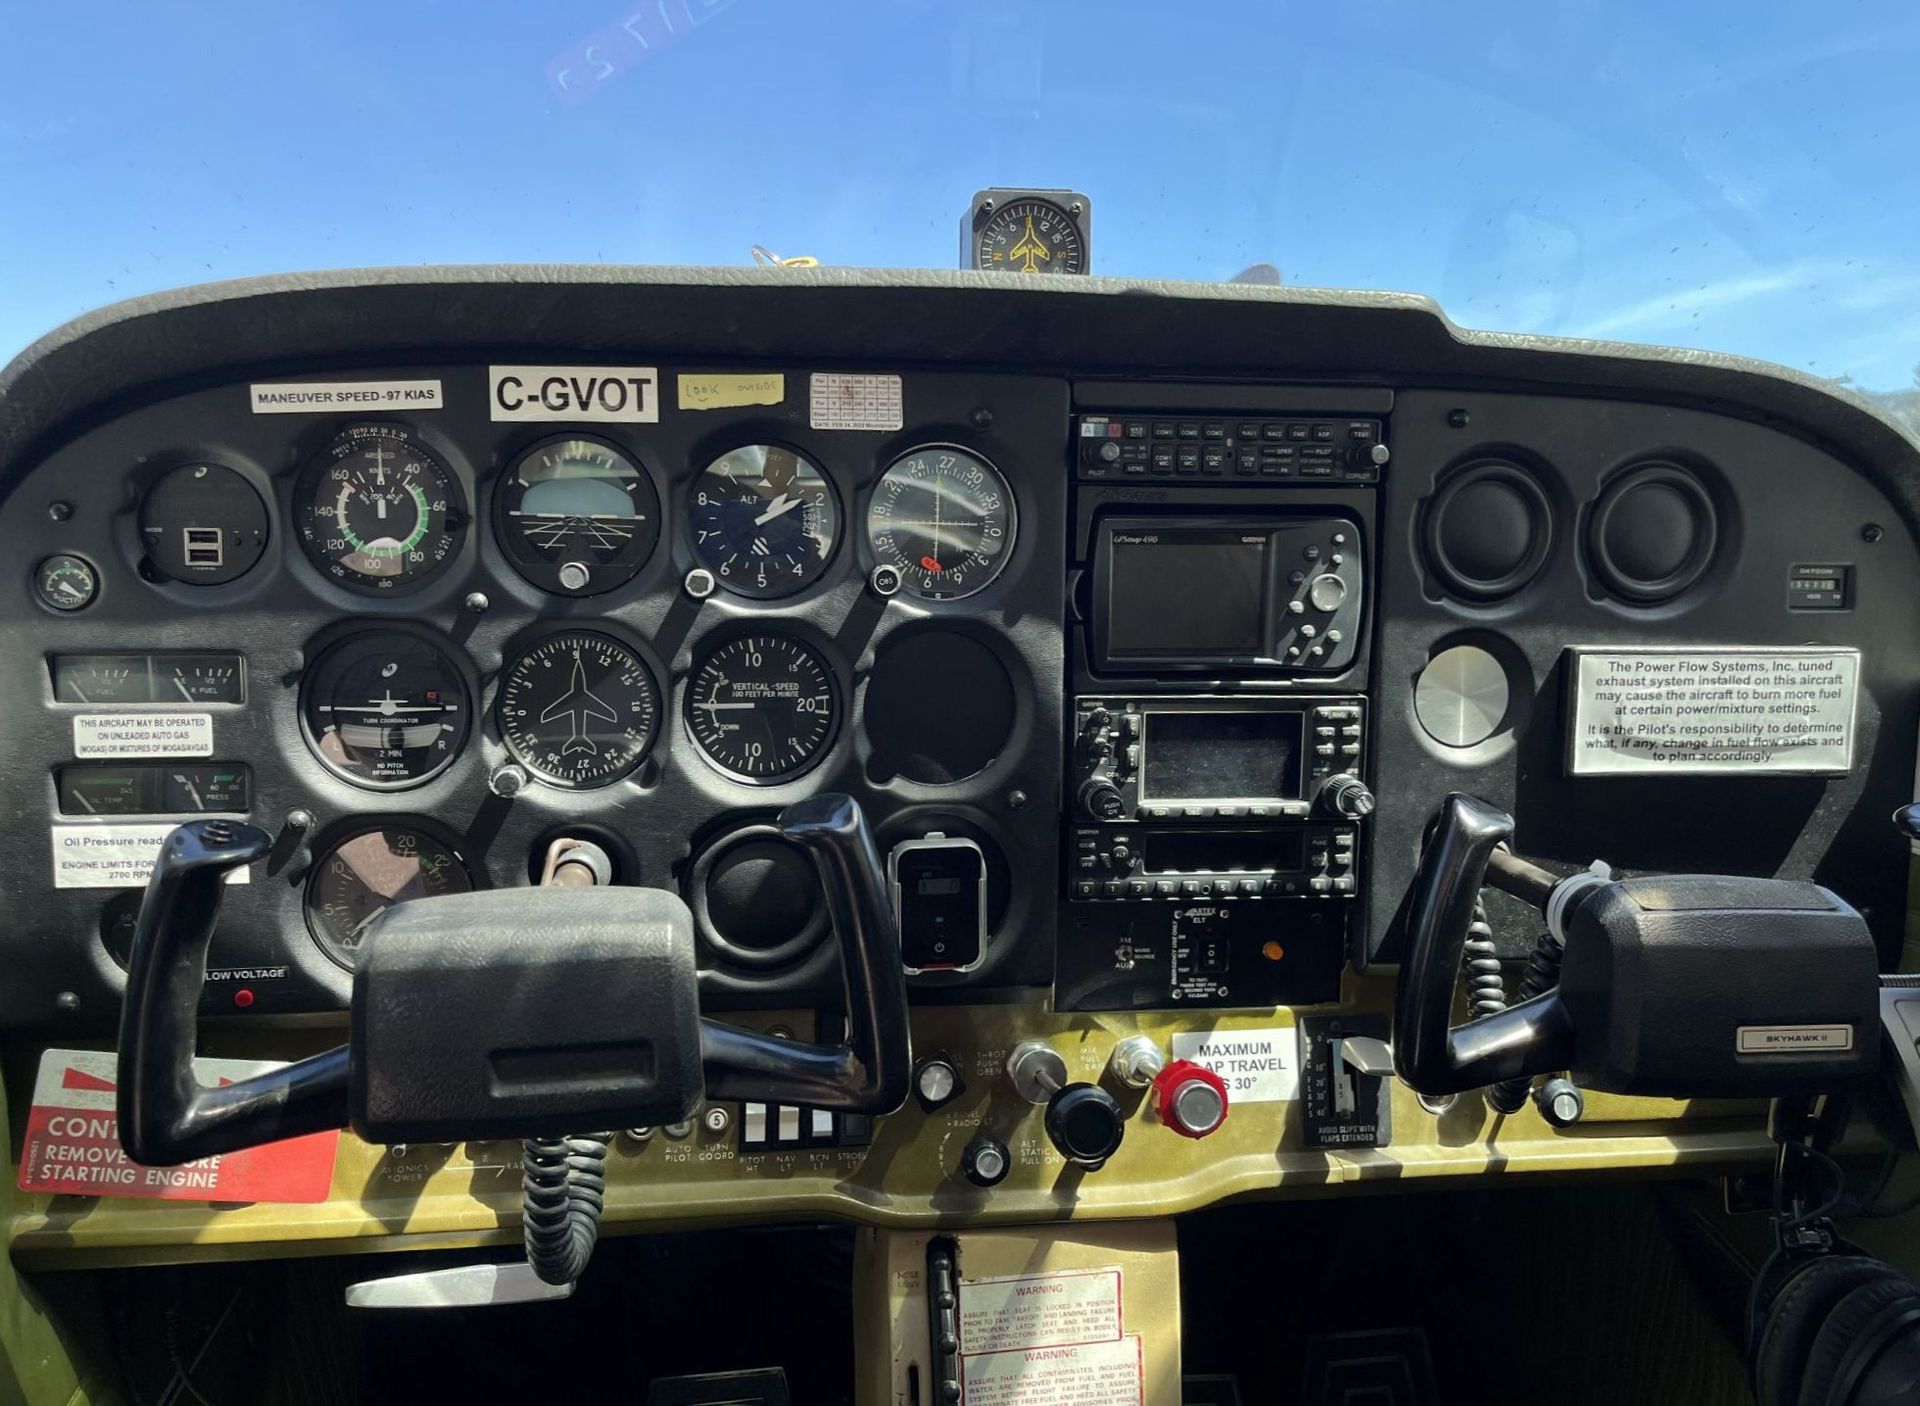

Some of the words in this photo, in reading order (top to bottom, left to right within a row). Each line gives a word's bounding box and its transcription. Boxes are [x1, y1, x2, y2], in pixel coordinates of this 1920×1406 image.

[1039, 221, 1050, 232] 12
[258, 392, 333, 404] MANEUVER
[404, 389, 435, 400] KIAS
[496, 377, 652, 413] C-GVOT
[404, 463, 420, 474] 40
[907, 459, 925, 474] 24
[939, 456, 956, 469] 27
[331, 469, 349, 480] 160
[965, 467, 984, 484] 30
[698, 492, 707, 506] 8
[740, 495, 758, 504] ALT
[815, 493, 824, 506] 2
[315, 506, 333, 517] 140
[432, 501, 447, 511] 60
[698, 530, 707, 544] 7
[327, 539, 345, 550] 120
[409, 551, 424, 562] 80
[364, 559, 381, 569] 100
[720, 562, 730, 575] 6
[792, 563, 804, 576] 4
[757, 575, 767, 588] 5
[598, 655, 611, 667] 12
[745, 652, 762, 667] 10
[788, 663, 798, 672] 15
[1608, 661, 1631, 672] The
[1635, 661, 1675, 672] Power
[1679, 661, 1708, 672] Flow
[1712, 661, 1768, 674] Systems,
[1772, 661, 1794, 672] Inc.
[1798, 660, 1833, 671] tuned
[719, 671, 724, 679] 5
[1596, 676, 1646, 687] exhaust
[1649, 676, 1694, 688] system
[1698, 675, 1750, 686] installed
[1754, 677, 1770, 685] on
[1773, 675, 1796, 685] this
[1799, 674, 1843, 685] aircraft
[732, 683, 770, 691] VERTICAL
[775, 682, 799, 691] SPEED
[1595, 692, 1621, 703] may
[1625, 692, 1662, 700] cause
[1666, 690, 1686, 700] the
[1689, 690, 1733, 700] aircraft
[1737, 690, 1749, 700] to
[1752, 690, 1781, 700] burn
[1784, 691, 1815, 699] more
[1819, 689, 1841, 699] fuel
[796, 698, 816, 712] 20
[1615, 706, 1627, 715] at
[1630, 704, 1672, 715] certain
[1676, 703, 1765, 717] power/mixture
[1768, 703, 1820, 716] settings.
[80, 720, 97, 728] THIS
[98, 720, 134, 728] AIRCRAFT
[136, 719, 152, 727] MAY
[154, 719, 164, 727] BE
[165, 719, 205, 727] OPERATED
[1588, 724, 1596, 734] It
[1599, 724, 1610, 734] is
[1614, 725, 1634, 735] the
[1638, 724, 1676, 734] Pilot's
[1680, 723, 1763, 736] responsibility
[1767, 724, 1779, 733] to
[1783, 723, 1843, 733] determine
[97, 732, 109, 740] ON
[110, 732, 150, 740] UNLEADED
[151, 731, 172, 740] AUTO
[174, 731, 189, 739] GAS
[788, 737, 797, 745] 15
[437, 740, 446, 750] R
[1585, 738, 1618, 750] what,
[1621, 738, 1631, 748] if
[1662, 738, 1708, 750] change
[1712, 738, 1723, 747] in
[1727, 737, 1750, 748] fuel
[1753, 737, 1779, 748] flow
[1782, 737, 1817, 747] exists
[1821, 736, 1844, 746] and
[745, 743, 761, 757] 10
[1652, 752, 1665, 761] to
[1669, 752, 1696, 763] plan
[1700, 751, 1774, 763] accordingly.
[64, 837, 80, 847] Oil
[83, 836, 134, 847] Pressure
[398, 835, 416, 848] 20
[62, 861, 98, 869] ENGINE
[101, 860, 132, 869] LIMITS
[134, 860, 155, 868] FOR
[331, 861, 345, 874] 10
[324, 904, 335, 916] 5
[206, 972, 232, 981] LOW
[233, 969, 285, 979] VOLTAGE
[1765, 1034, 1819, 1043] SKYHAWK
[1199, 1042, 1272, 1057] MAXIMUM
[1230, 1057, 1287, 1073] TRAVEL
[1236, 1076, 1258, 1090] 30°
[713, 1114, 721, 1126] 5
[1020, 1140, 1036, 1148] ALT
[45, 1145, 128, 1164] REMOVE
[776, 1155, 796, 1163] NAV
[1020, 1157, 1040, 1165] PULL
[1044, 1156, 1060, 1165] ON
[41, 1164, 135, 1184] STARTING
[145, 1169, 218, 1188] ENGINE
[1016, 1283, 1063, 1297] WARNING
[1024, 1348, 1078, 1362] WARNING
